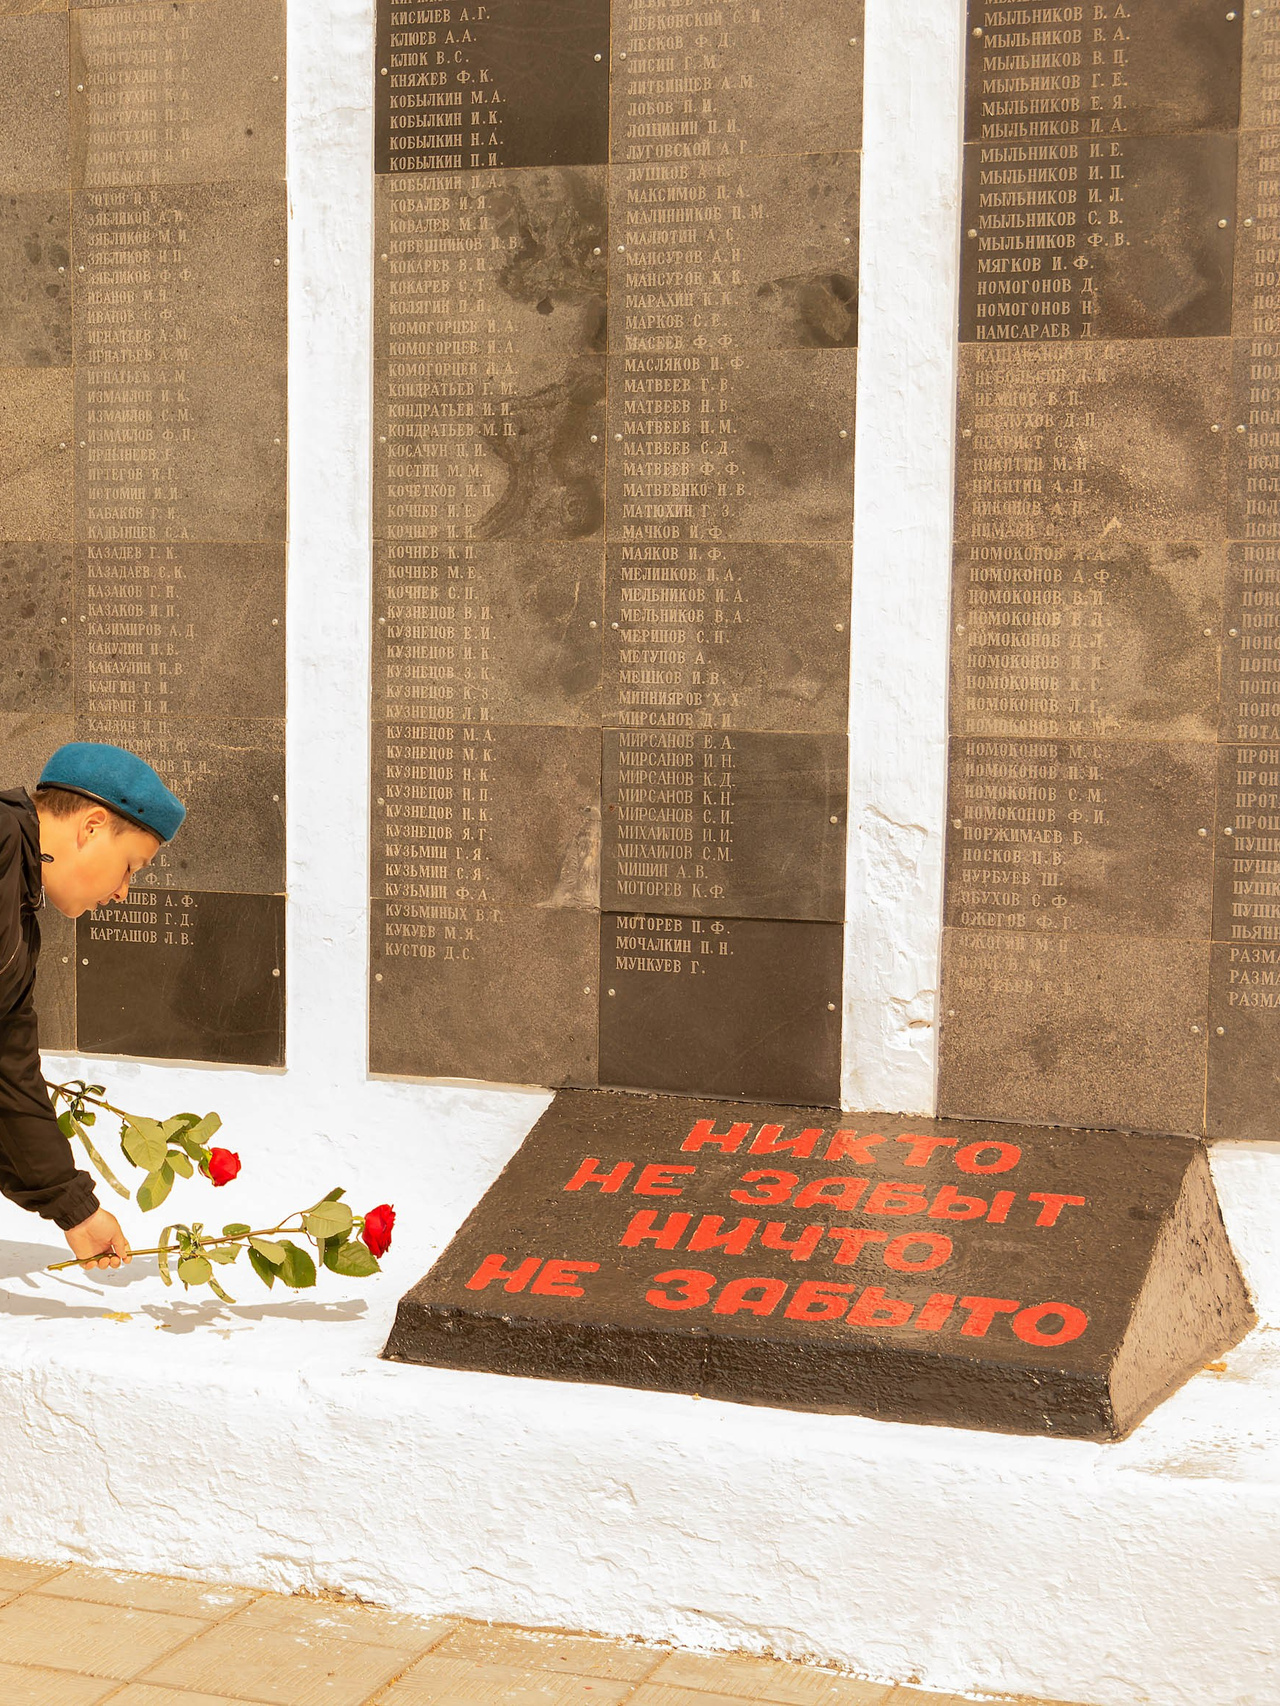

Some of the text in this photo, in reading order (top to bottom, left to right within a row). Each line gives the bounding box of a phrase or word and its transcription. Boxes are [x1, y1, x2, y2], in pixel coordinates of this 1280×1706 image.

[391, 9, 450, 26] КИСИЛЕВ
[984, 7, 1083, 27] МЫЛЬНИКОВ
[391, 32, 436, 47] КЛЮЕВ
[391, 52, 428, 67] КЛЮК
[391, 72, 447, 88] КНЯЖЕВ
[983, 75, 1080, 94] МЫЛЬНИКОВ
[390, 92, 462, 108] КОБЫЛКИН
[390, 113, 462, 129] КОБЫЛКИН
[390, 134, 462, 150] КОБЫЛКИН
[390, 155, 461, 171] КОБЫЛКИН
[978, 258, 1041, 273] МЯГКОВ
[977, 279, 1071, 296] НОМОГОНОВ
[977, 302, 1070, 318] НОМОГОНОВ
[977, 324, 1070, 339] НАМСАРАЕВ
[624, 379, 691, 392] МАТВЕЕВ
[88, 604, 142, 617] КАЗАКОВ
[619, 733, 694, 749] МИРСАНОВ
[618, 844, 692, 859] МИХАИЛОВ
[617, 862, 669, 877] МИШИН
[617, 880, 681, 897] МОТОРЕВ
[91, 909, 157, 924] КАРТАШОВ
[616, 916, 682, 932] МОТОРЕВ
[90, 927, 157, 943] КАРТАШОВ
[386, 923, 435, 938] КУКУЕВ
[386, 943, 435, 958] КУСТОВ
[616, 936, 691, 953] МОЧАЛКИН
[616, 956, 705, 974] МУНКУЕВ Г.
[681, 1119, 1023, 1175] НИКТО
[564, 1158, 1086, 1227] НЕ ЗАБЫТ
[620, 1209, 953, 1273] НИЧТО
[465, 1254, 1088, 1348] НЕ ЗАБЫТО
